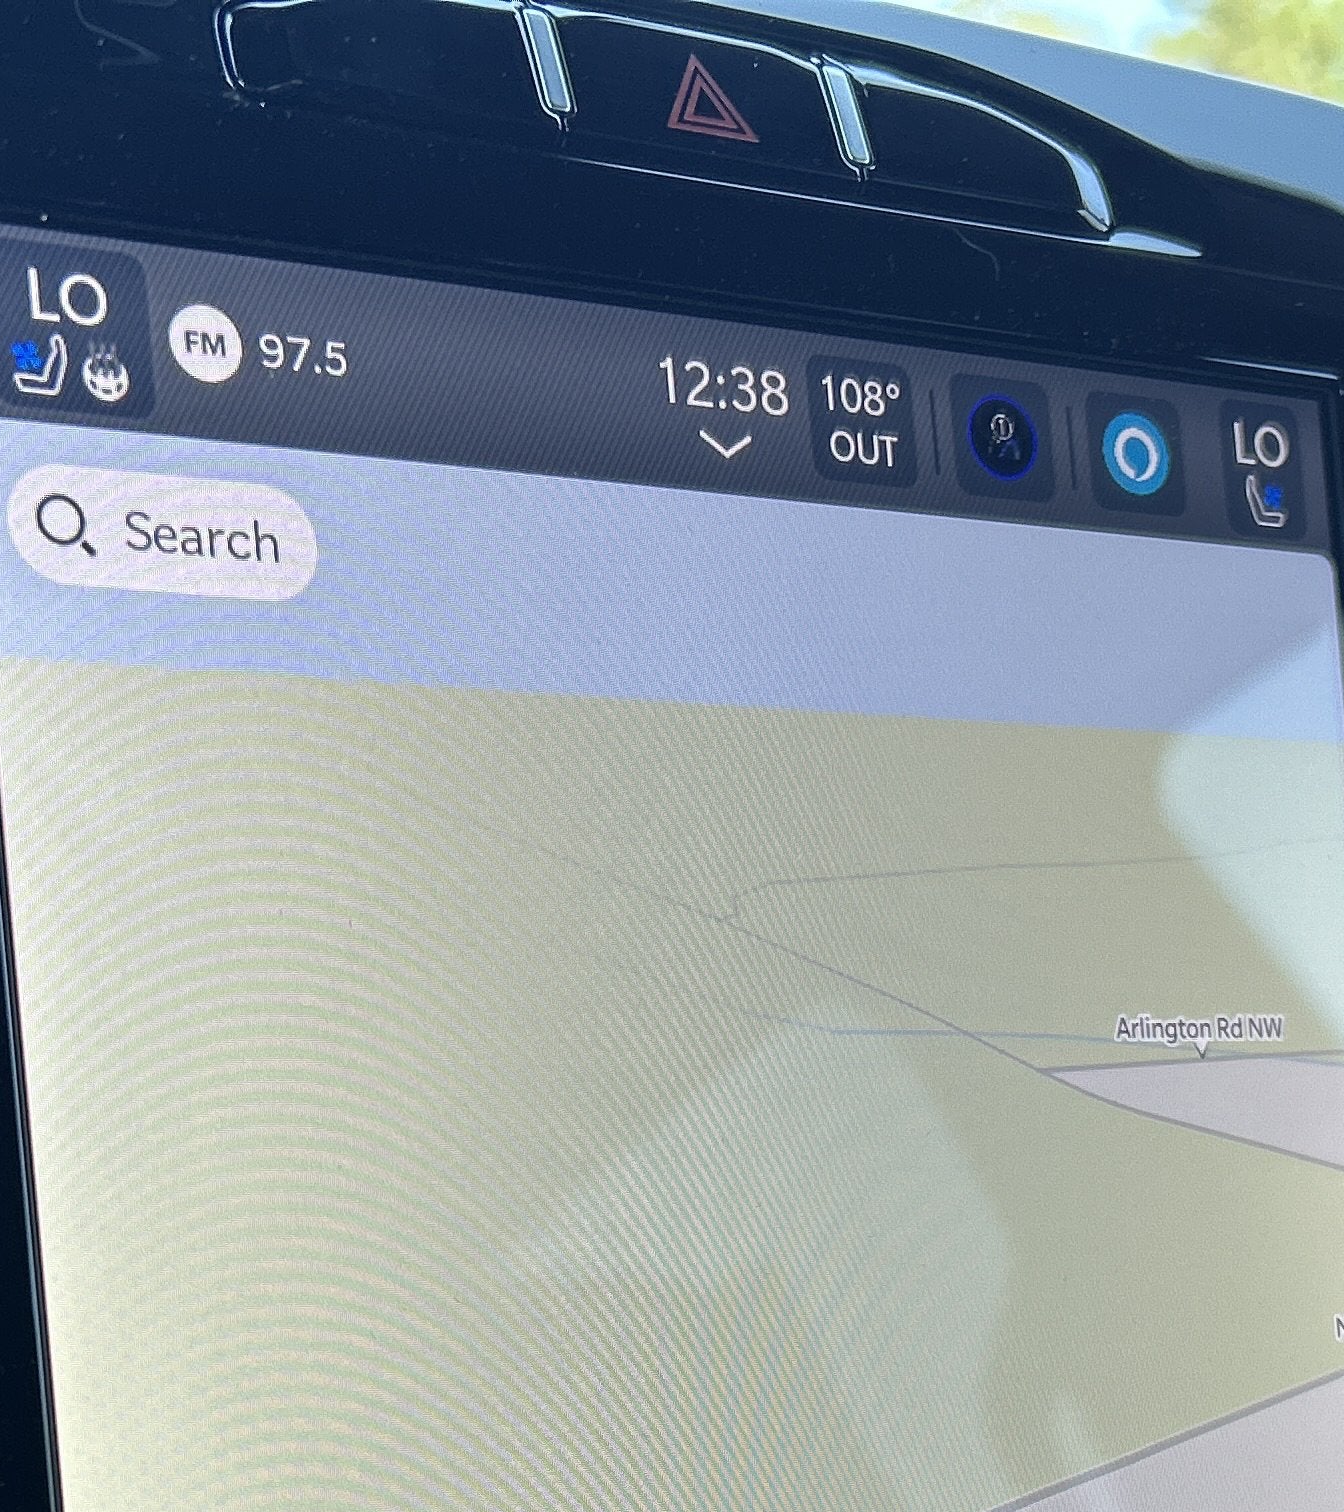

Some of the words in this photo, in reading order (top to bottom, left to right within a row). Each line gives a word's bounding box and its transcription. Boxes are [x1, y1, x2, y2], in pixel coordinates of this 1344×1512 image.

[26, 266, 108, 326] LO
[183, 329, 227, 358] FM
[258, 333, 348, 378] 97.5
[658, 357, 790, 417] 12:38
[829, 430, 899, 469] OUT
[1233, 418, 1288, 469] LO
[124, 510, 280, 563] Search
[1117, 1016, 1210, 1042] Arlington
[1217, 1017, 1243, 1038] Rd
[1249, 1017, 1283, 1038] NW
